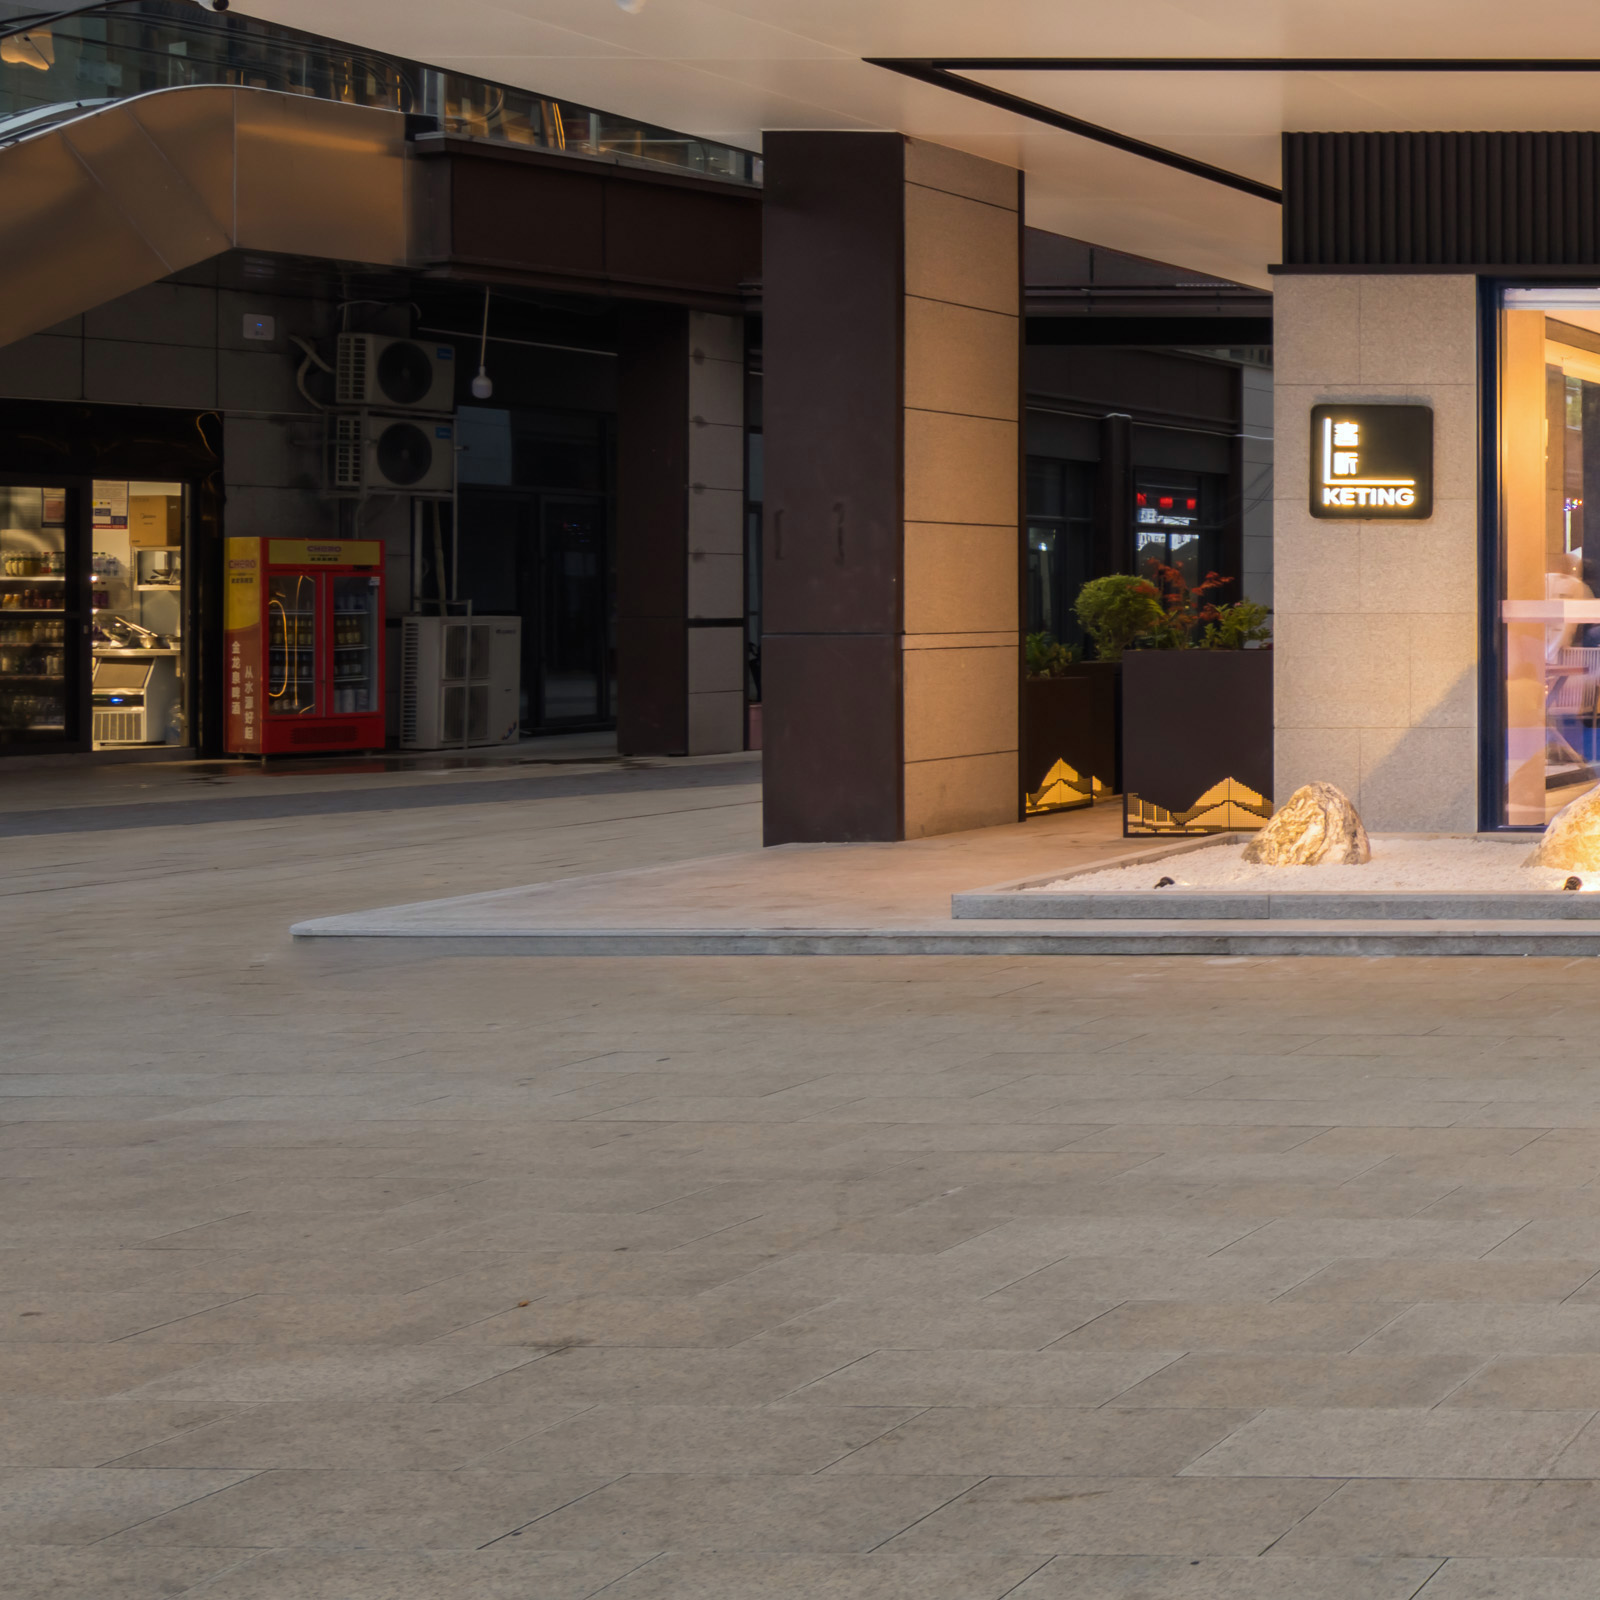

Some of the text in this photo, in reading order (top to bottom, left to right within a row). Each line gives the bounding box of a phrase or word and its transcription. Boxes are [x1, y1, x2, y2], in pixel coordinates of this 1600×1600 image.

[1322, 486, 1416, 507] KETING
[231, 640, 241, 715] 金龙泉啤酒
